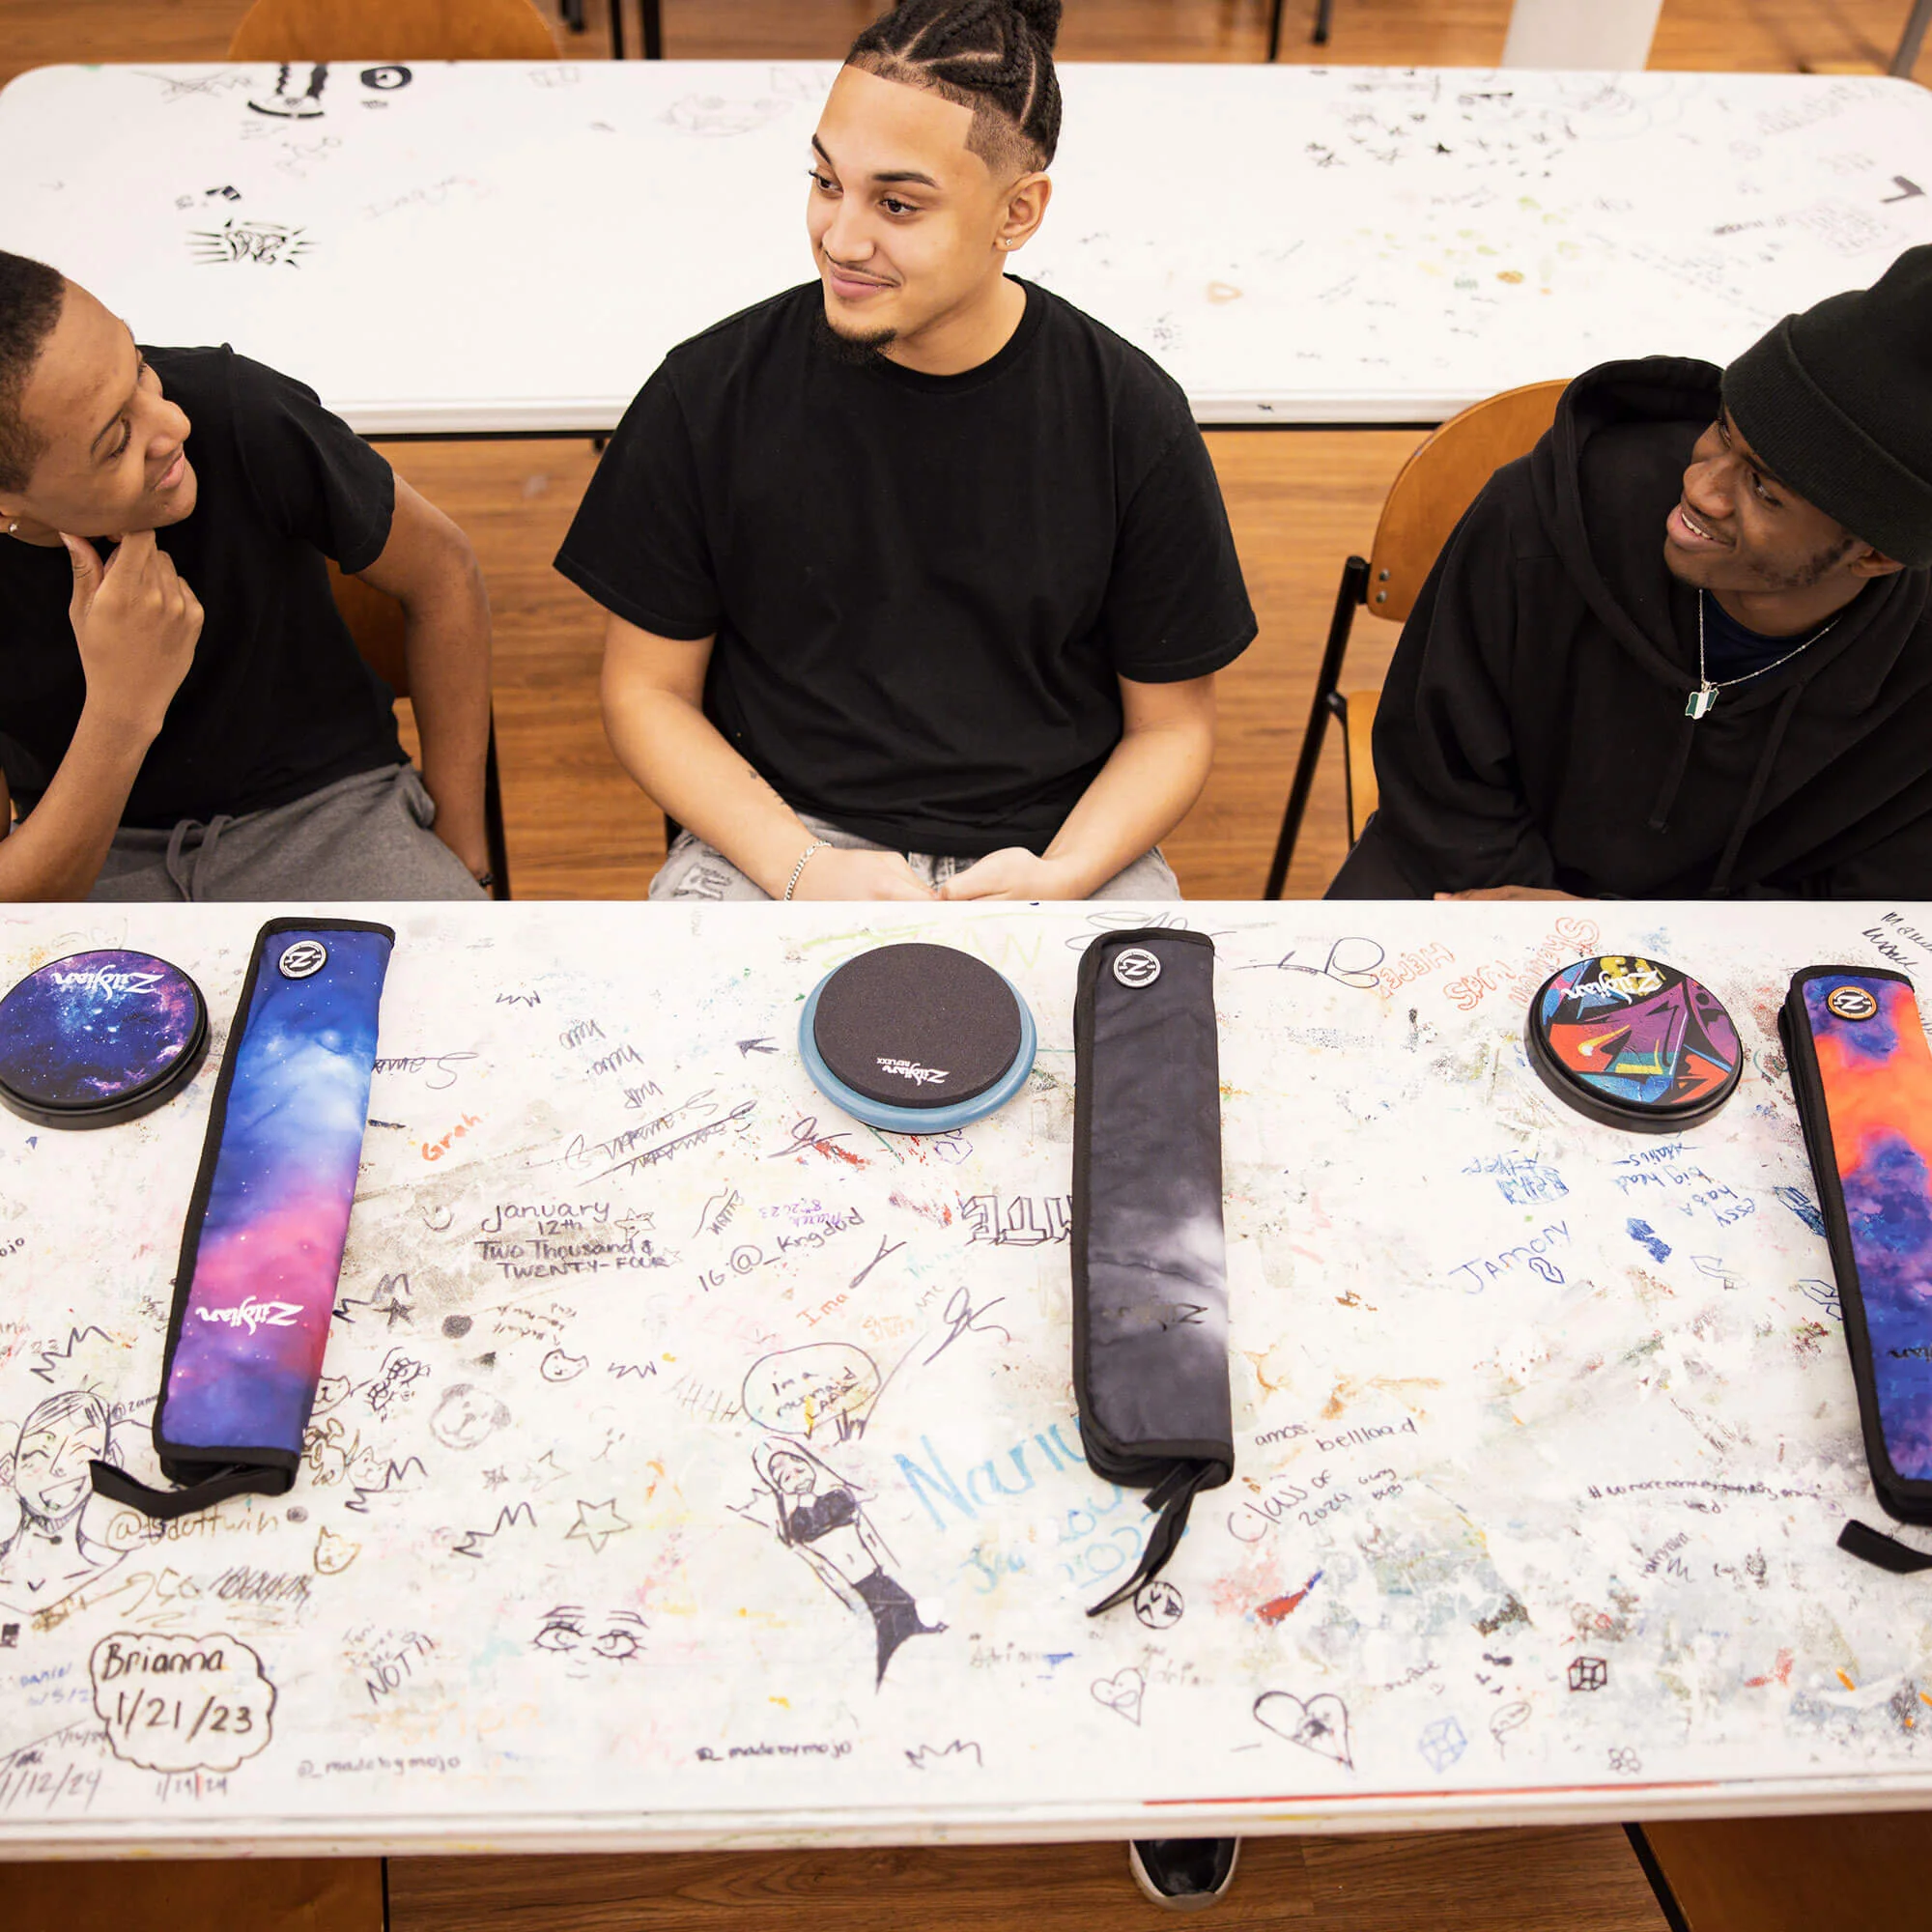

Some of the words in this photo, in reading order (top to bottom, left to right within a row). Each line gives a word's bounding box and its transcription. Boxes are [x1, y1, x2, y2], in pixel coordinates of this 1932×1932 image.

[50, 964, 165, 1000] Zildjian
[1562, 969, 1664, 1005] Zildjian
[881, 1063, 950, 1086] Zildjian
[481, 1202, 610, 1233] January
[537, 1220, 582, 1236] 12th
[526, 1238, 636, 1260] Thousand
[195, 1295, 304, 1334] Zildjian
[102, 1643, 224, 1681] Brianna
[118, 1689, 252, 1742] 1/21/23
